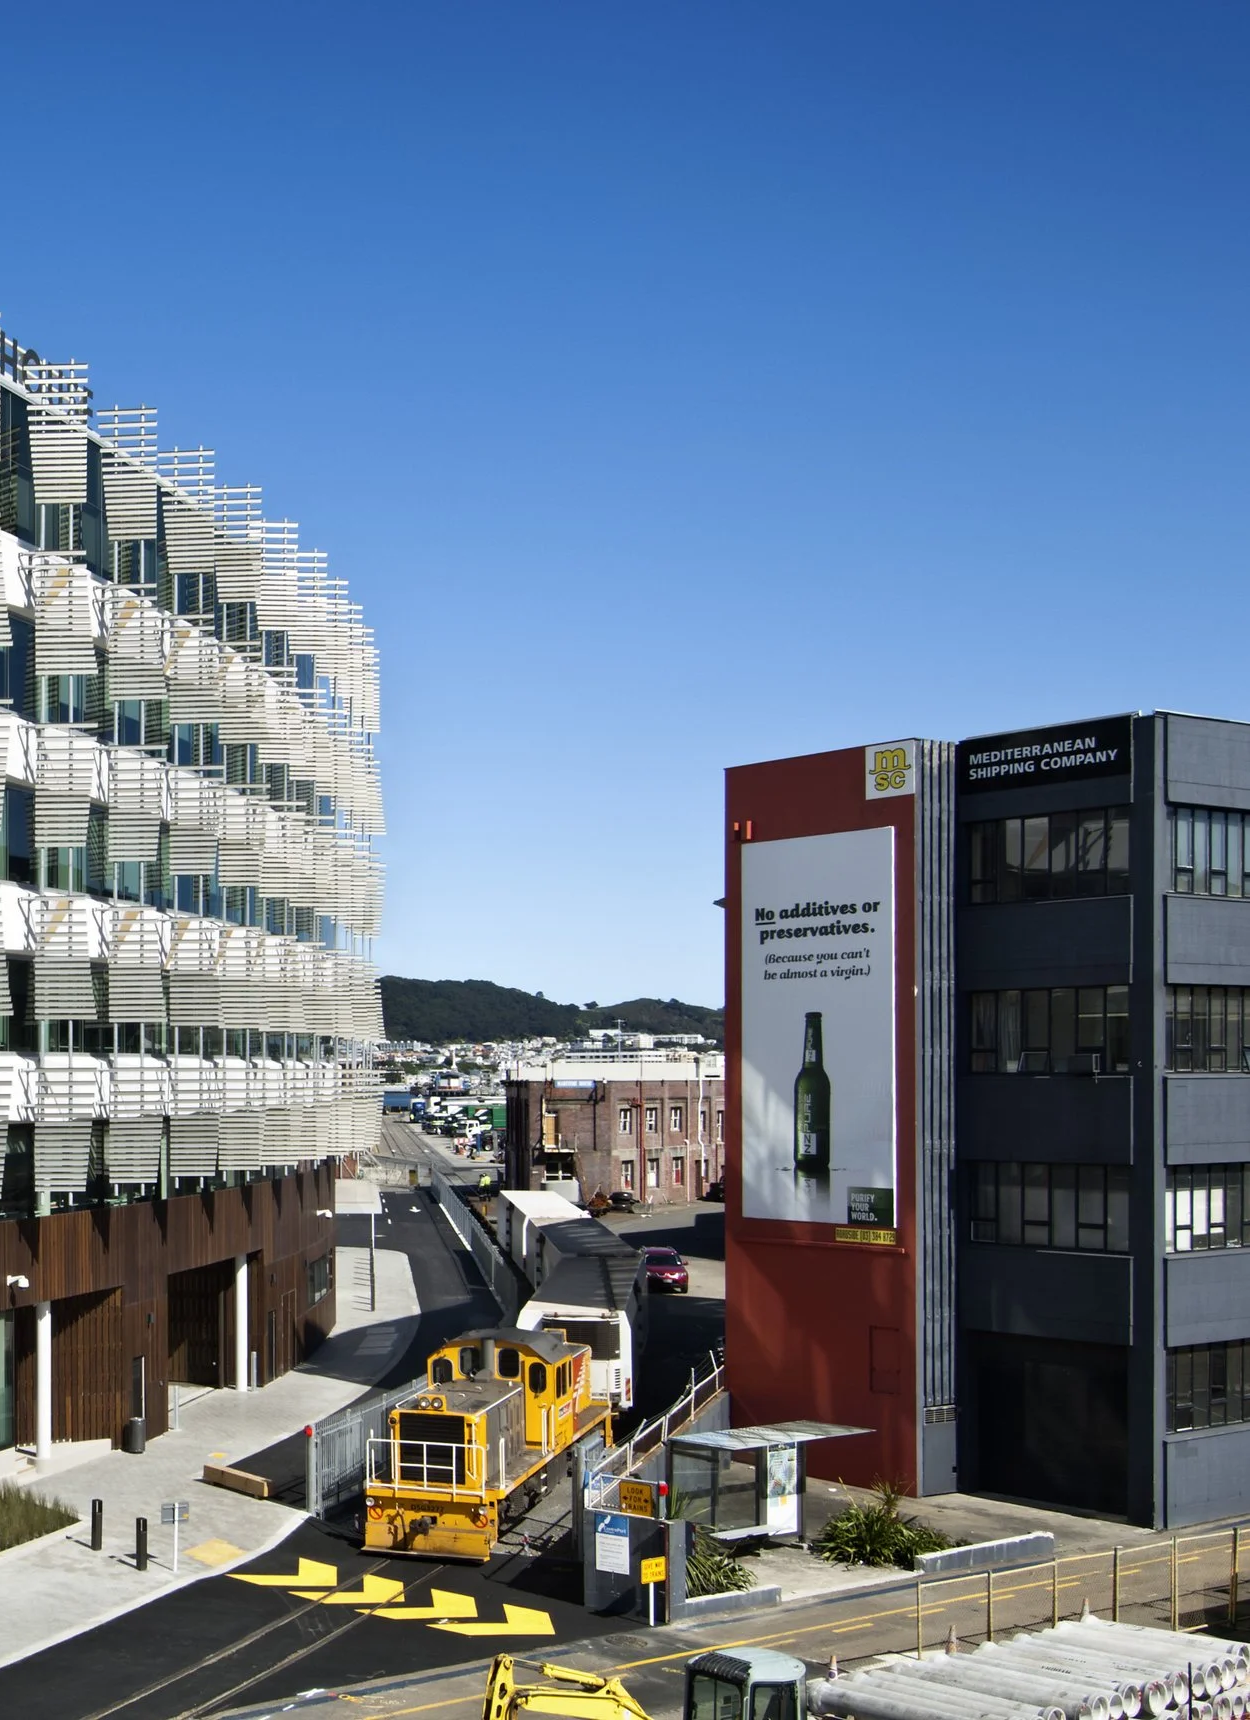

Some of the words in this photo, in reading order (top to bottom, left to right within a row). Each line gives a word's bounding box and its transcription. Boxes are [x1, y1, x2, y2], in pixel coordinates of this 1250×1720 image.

[969, 736, 1096, 766] MEDITERRANEAN
[969, 762, 1035, 780] SHIPPING
[1040, 749, 1118, 771] COMPANY
[755, 908, 775, 926] No
[779, 901, 857, 919] additives
[862, 901, 880, 913] or
[760, 920, 875, 945] preservatives.
[764, 953, 814, 965] (Because
[816, 952, 838, 965] you
[841, 947, 870, 960] can't
[764, 969, 777, 980] be
[779, 967, 817, 979] almost
[820, 970, 827, 978] a
[830, 964, 871, 980] virgin.)
[851, 1193, 874, 1203] PURIFY
[851, 1202, 869, 1211] YOUR
[851, 1211, 878, 1221] WORLD.
[626, 1487, 643, 1495] LOOK
